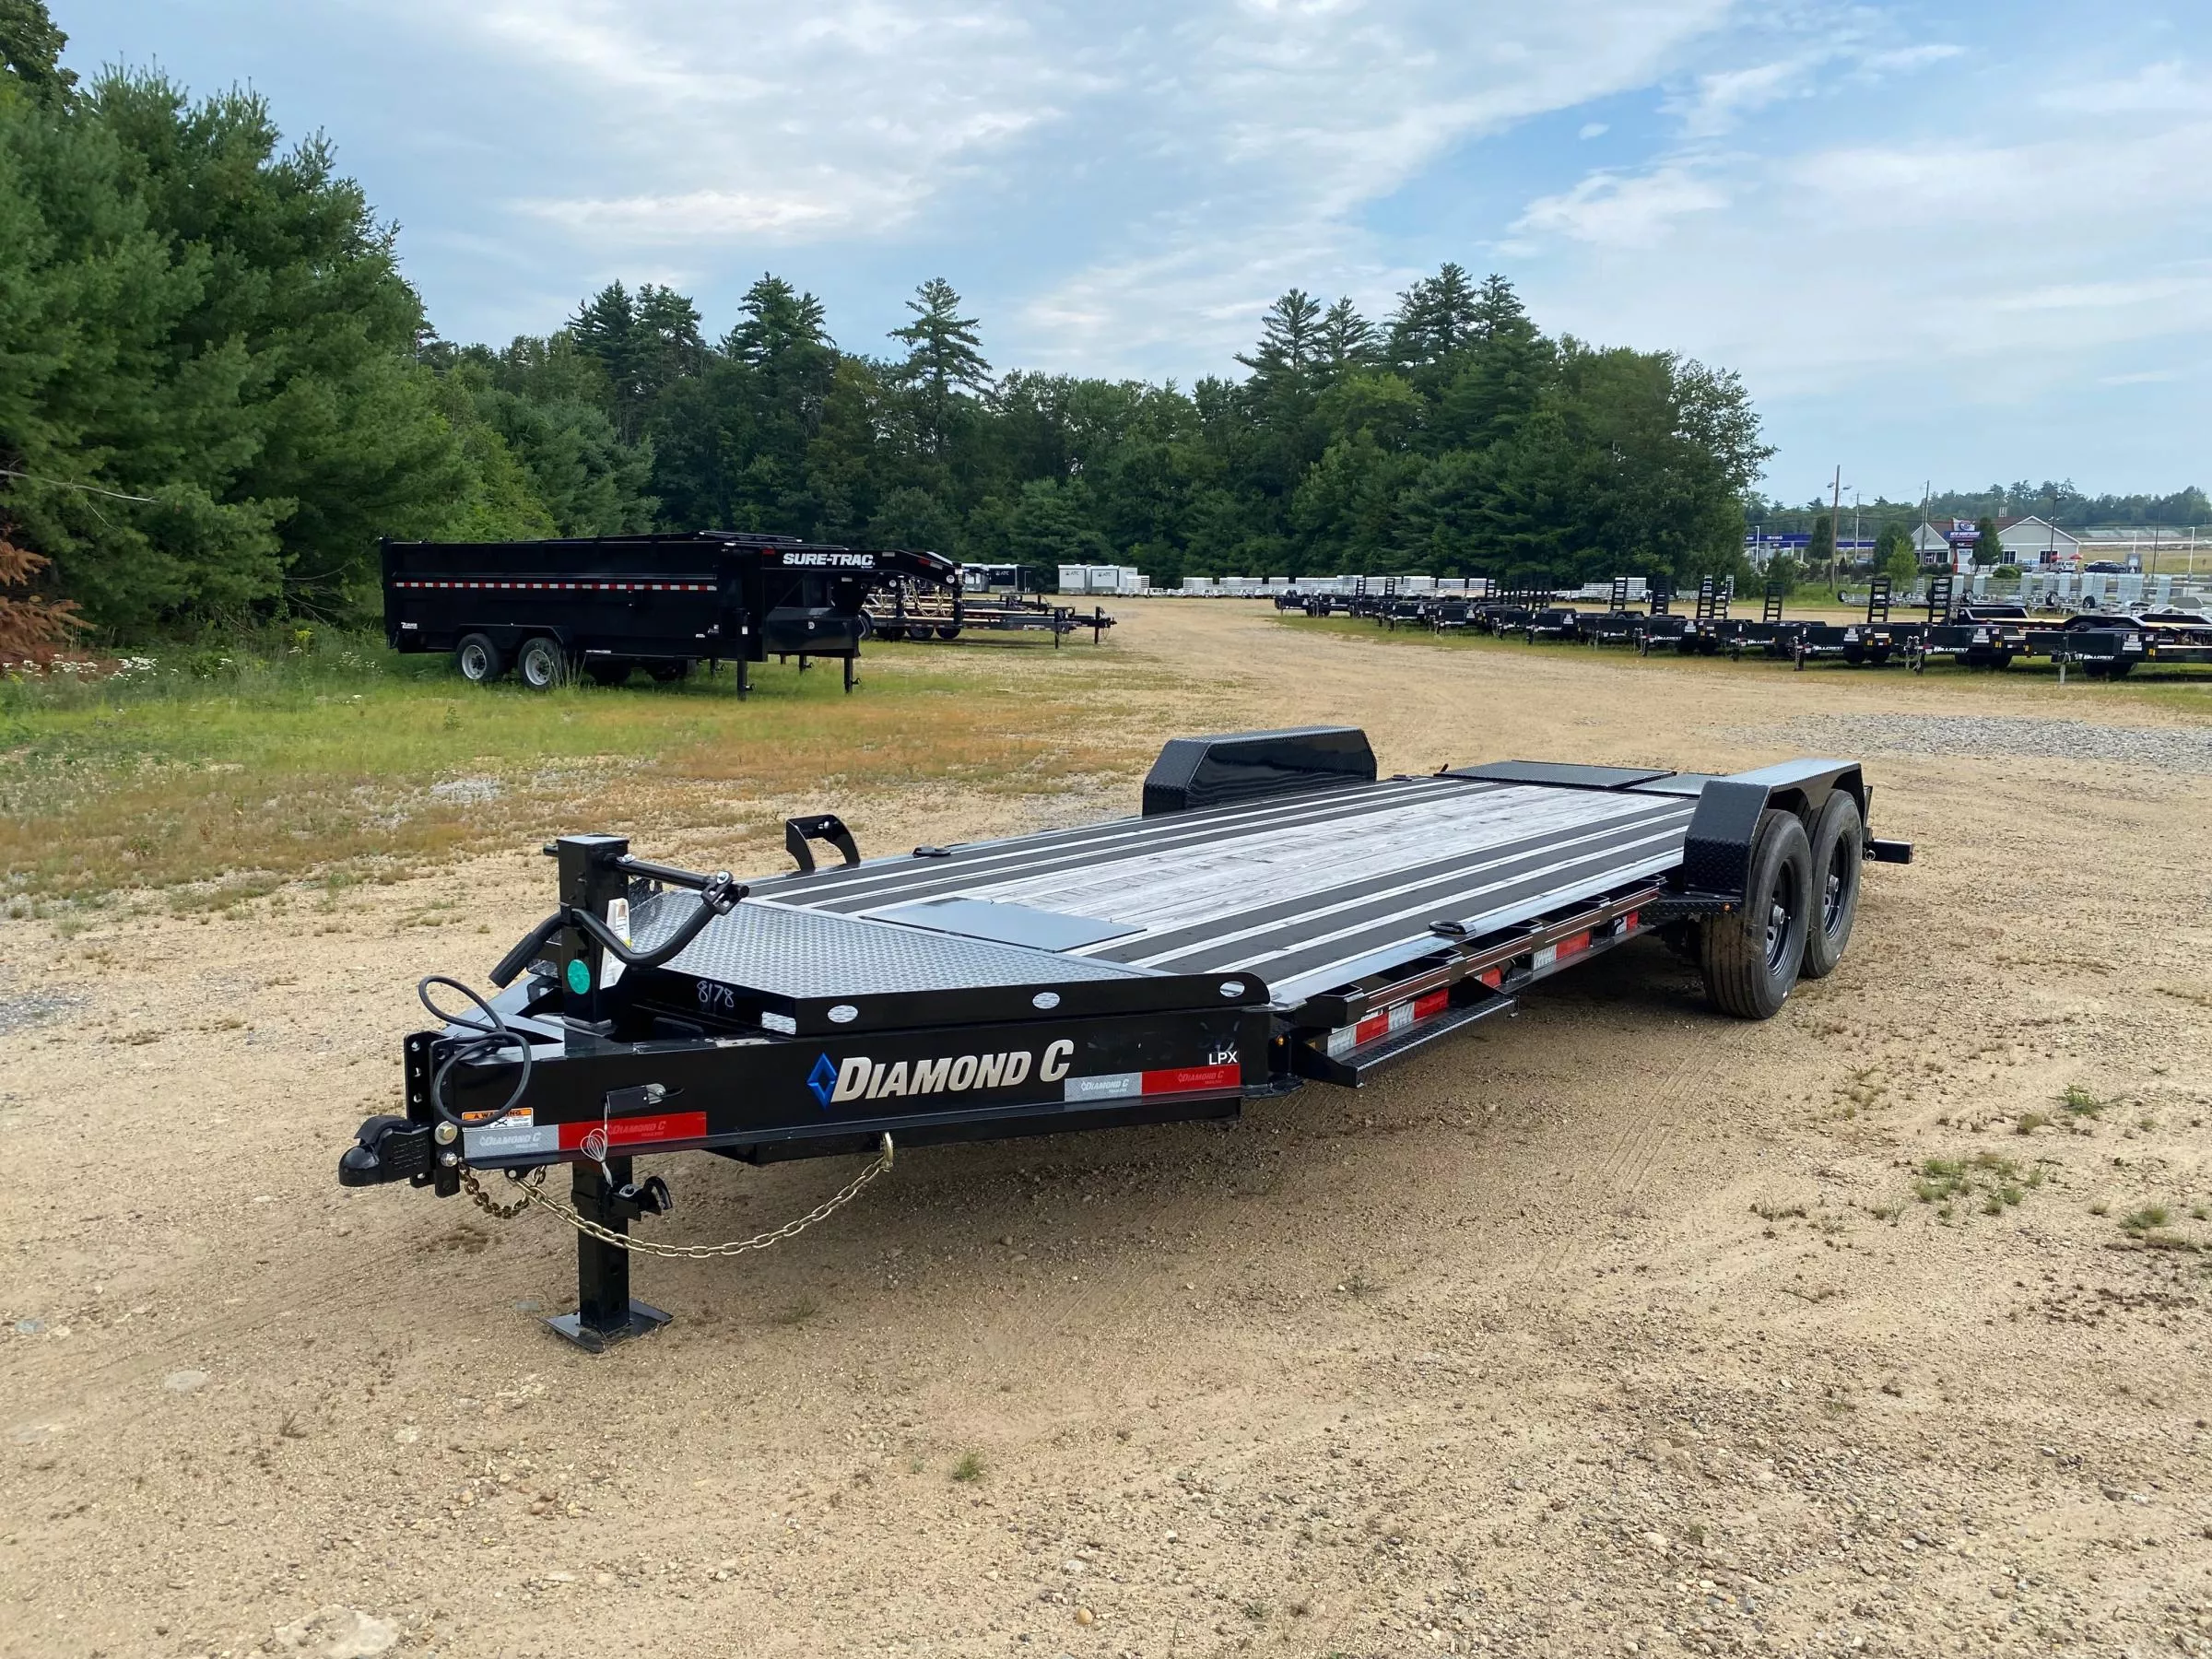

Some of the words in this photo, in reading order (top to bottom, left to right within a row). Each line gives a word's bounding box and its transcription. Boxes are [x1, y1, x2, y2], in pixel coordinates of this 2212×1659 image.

[782, 553, 874, 566] SURE-TRAC
[697, 981, 735, 1007] 8178
[1208, 1051, 1238, 1065] LPX
[830, 1051, 1032, 1103] DIAMOND
[1039, 1039, 1075, 1083] C
[611, 1123, 656, 1135] DIAMOND
[657, 1121, 666, 1131] C
[484, 1135, 532, 1146] DIAMOND
[532, 1132, 542, 1142] C
